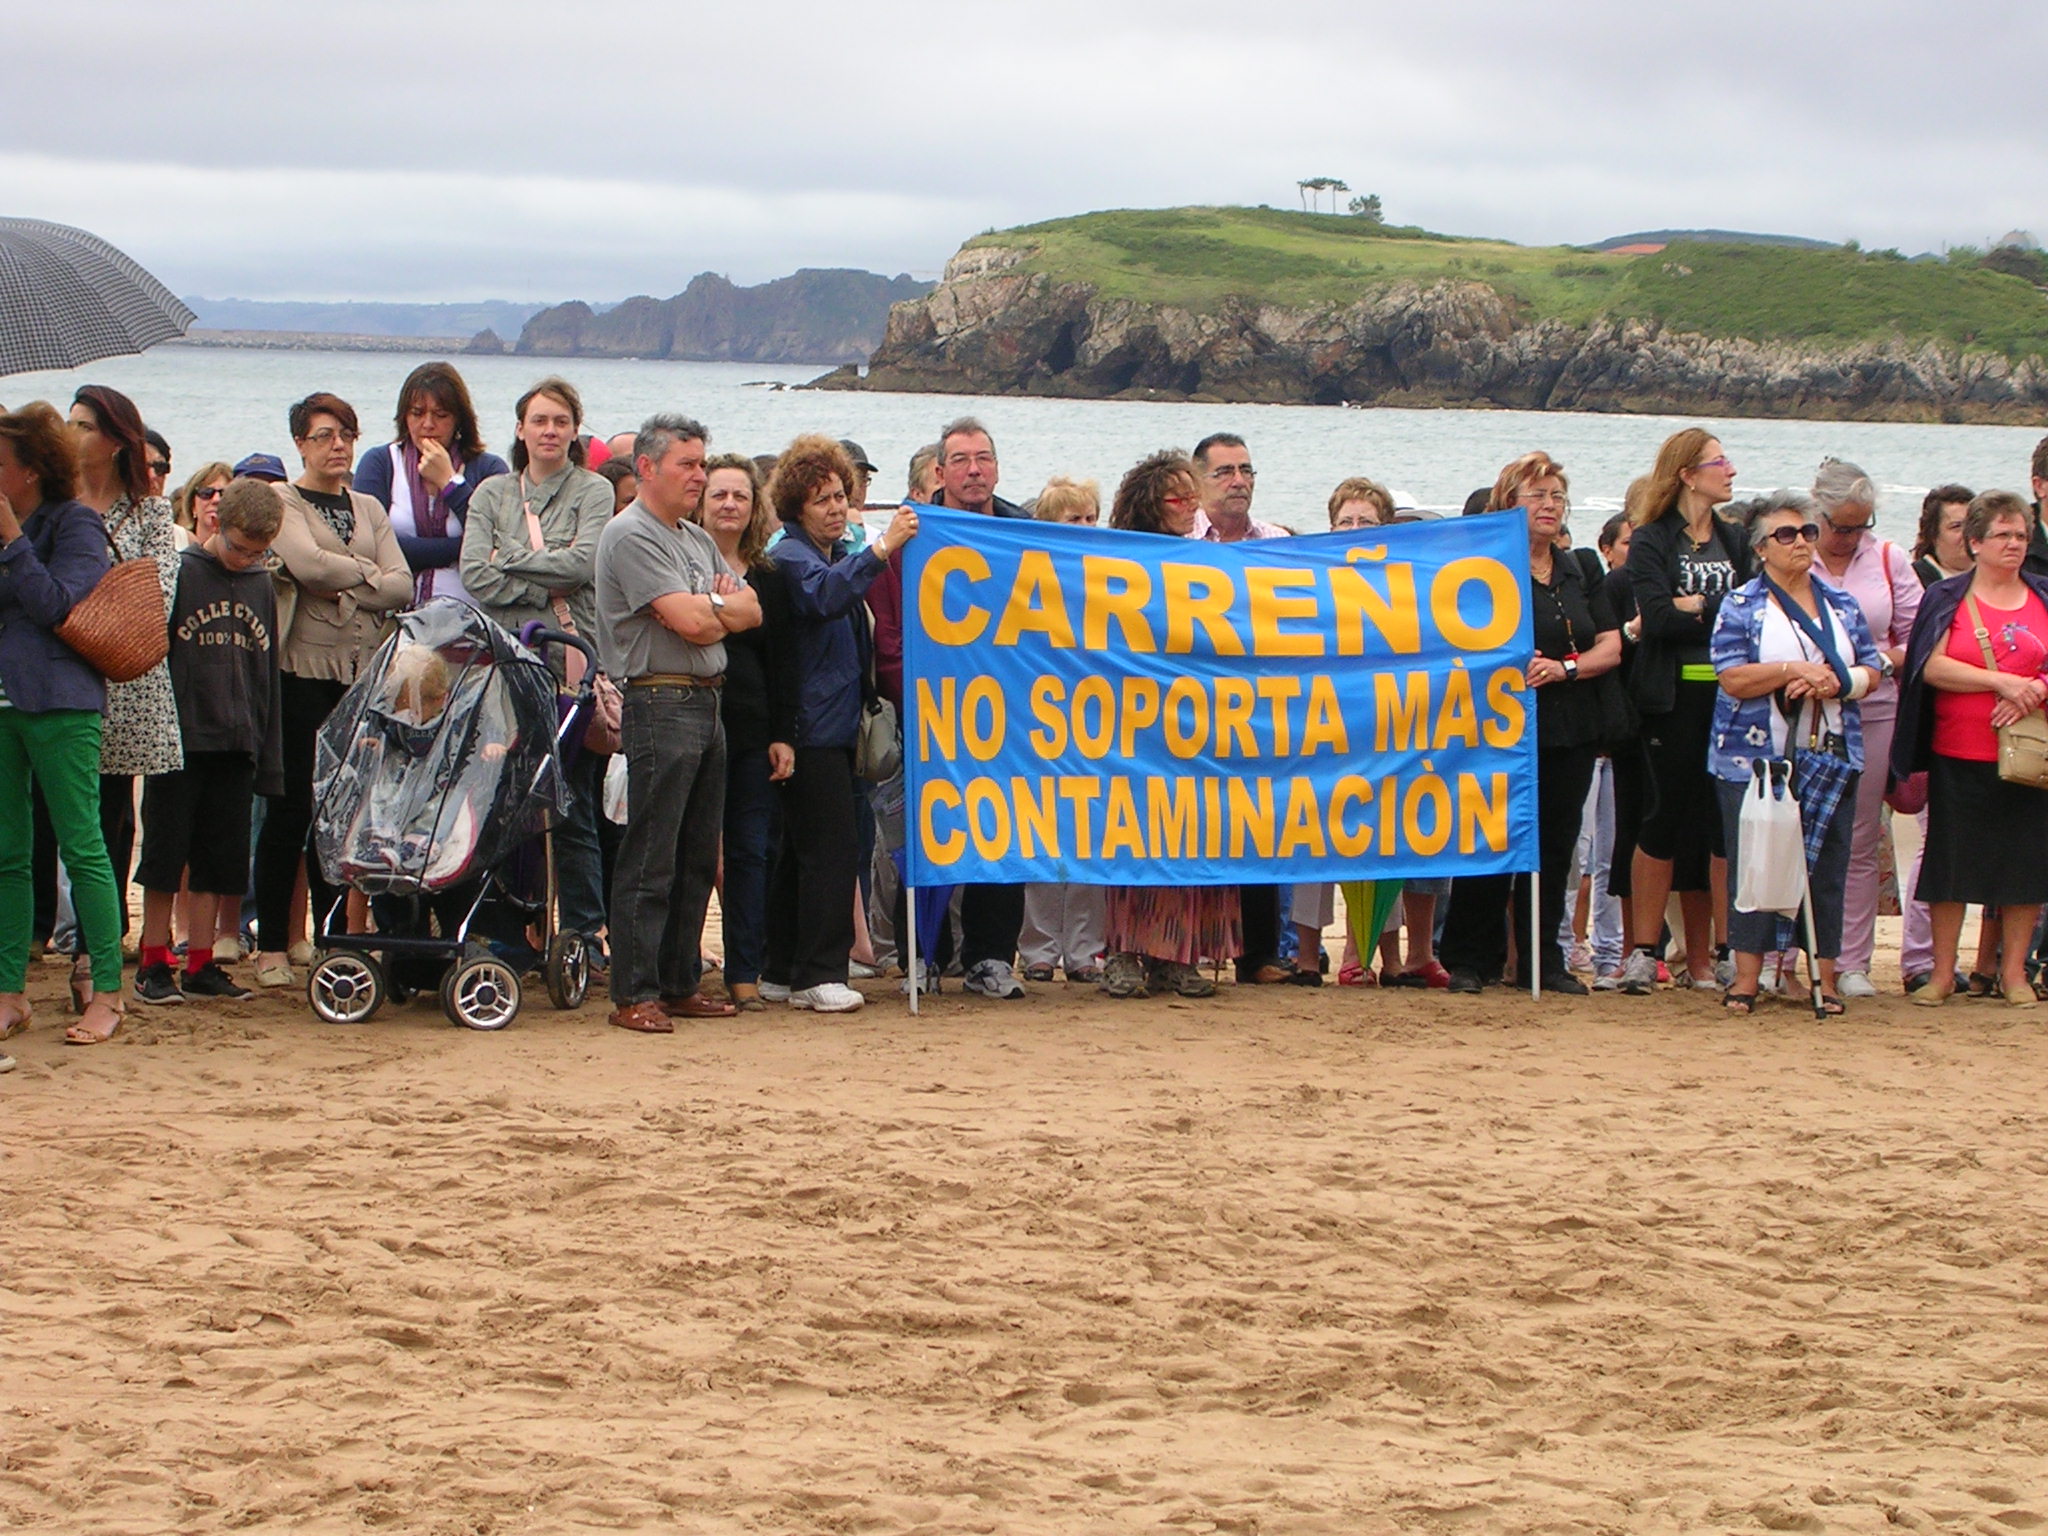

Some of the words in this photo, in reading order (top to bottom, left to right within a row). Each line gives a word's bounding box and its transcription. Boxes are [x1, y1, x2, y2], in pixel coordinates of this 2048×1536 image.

[178, 600, 271, 652] COLLECTION
[919, 546, 1521, 657] CARREÑO
[199, 631, 231, 646] 100%
[918, 676, 1005, 761] NO
[1030, 676, 1348, 759] SOPORTA
